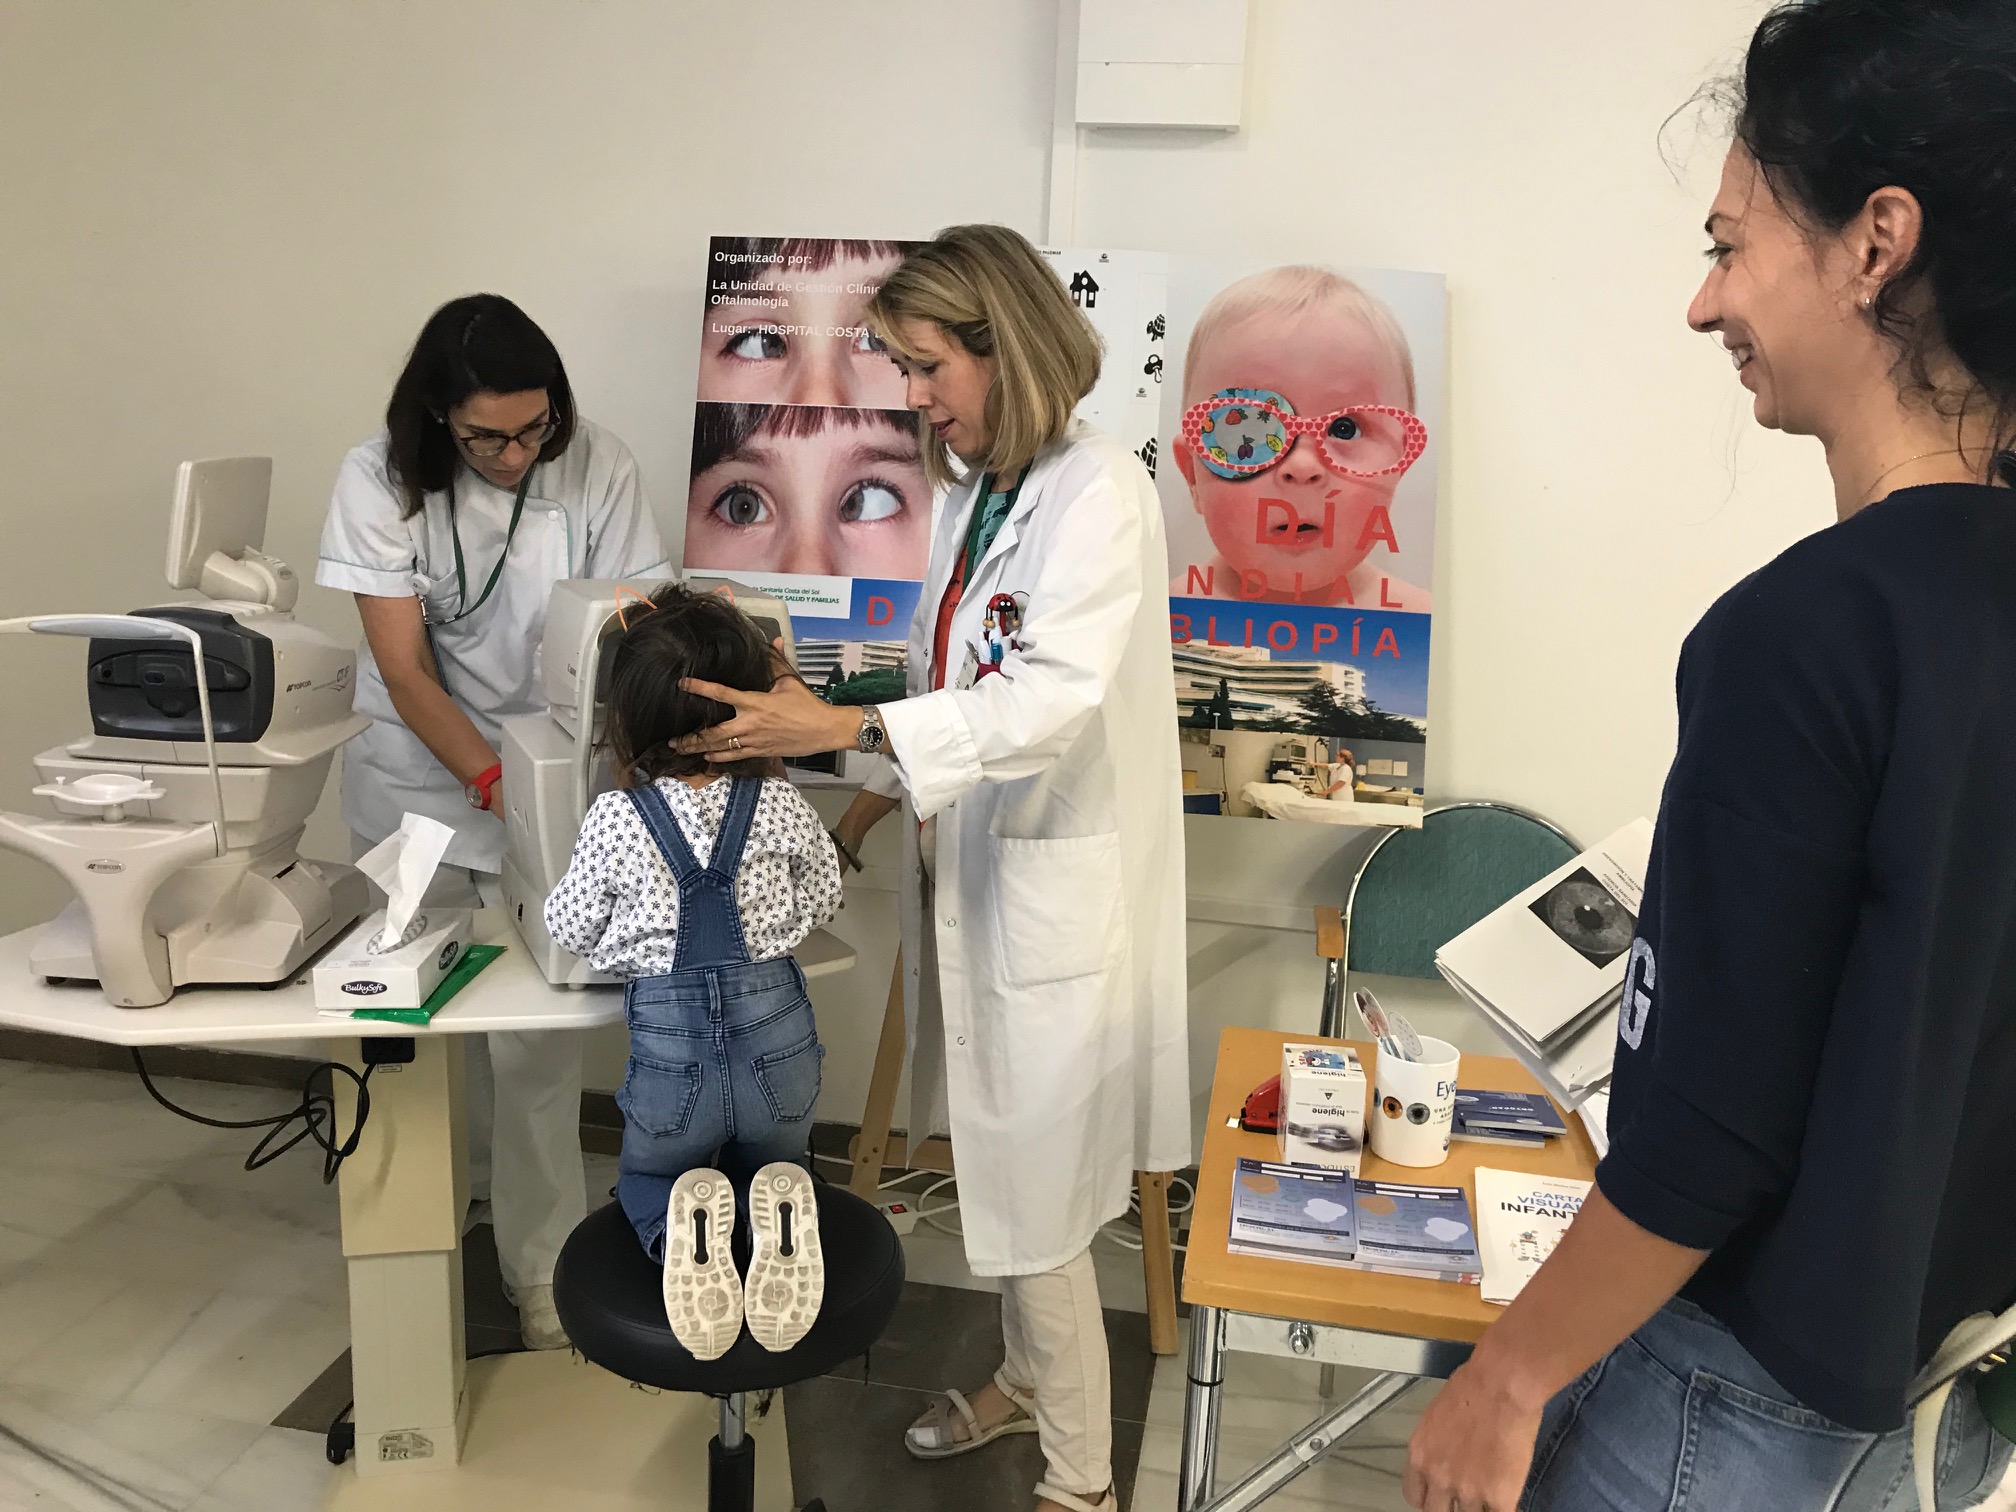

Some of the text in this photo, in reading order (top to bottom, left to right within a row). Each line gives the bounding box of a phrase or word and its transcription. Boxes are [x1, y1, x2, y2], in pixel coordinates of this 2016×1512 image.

[714, 252, 812, 265] Organizado por:
[712, 280, 881, 295] La Unidad de Gestión Clínic
[711, 294, 789, 308] Oftalmología
[712, 322, 870, 338] Lugar: HOSPITAL COSTA
[1256, 489, 1400, 553] DÍA
[1187, 565, 1403, 608] NDIAL
[866, 595, 894, 626] D
[1170, 613, 1400, 658] BLIOPÍA
[345, 984, 384, 994] BulkySoft
[1312, 1107, 1345, 1117] higiene
[1532, 1191, 1584, 1203] CARTA
[1501, 1202, 1578, 1219] INFANT
